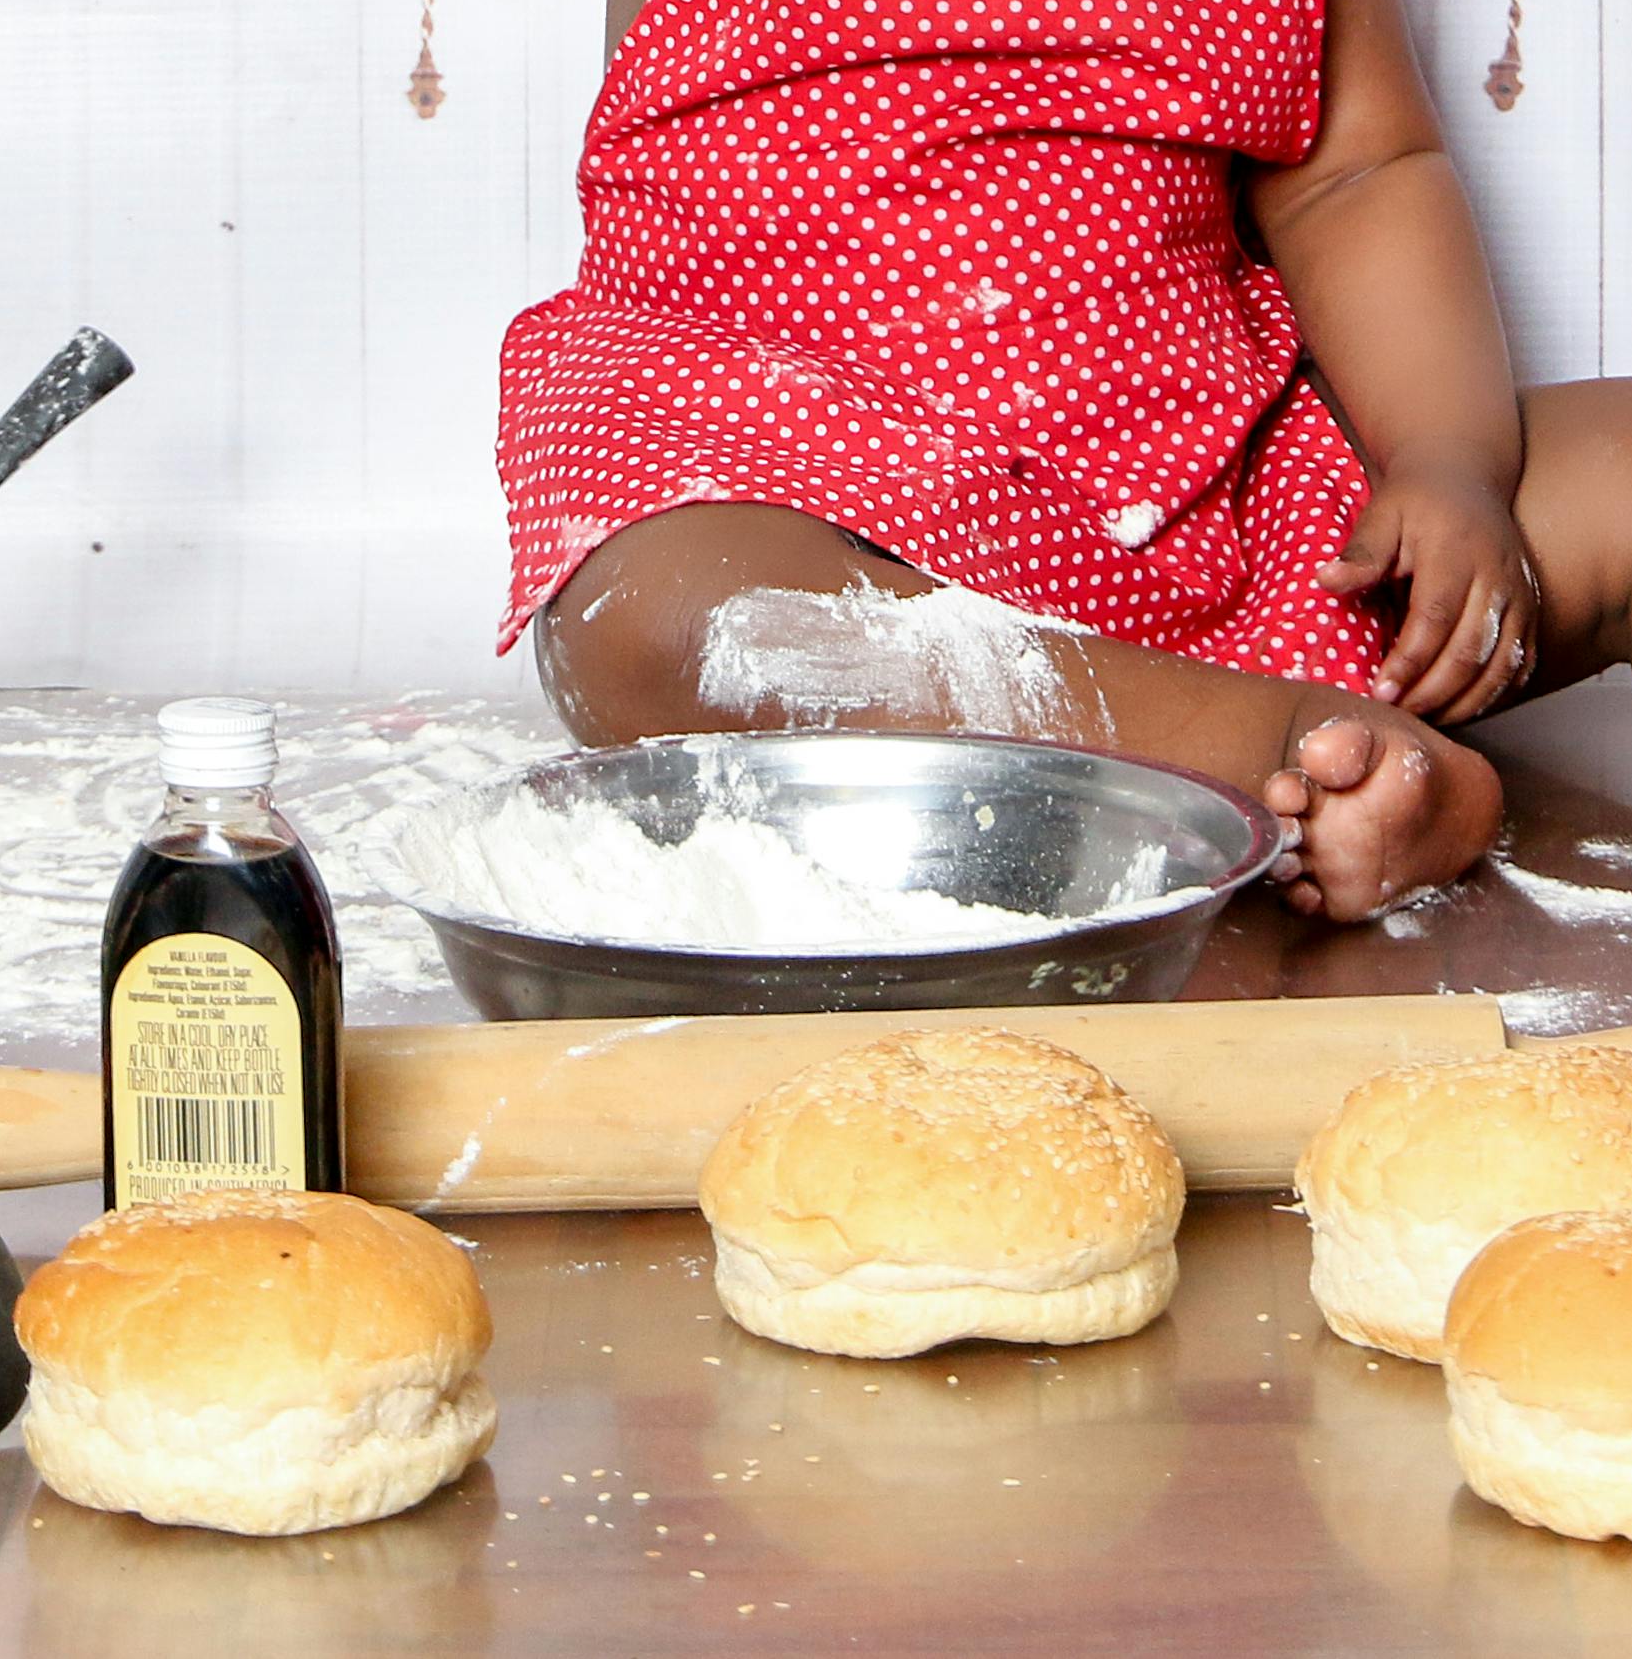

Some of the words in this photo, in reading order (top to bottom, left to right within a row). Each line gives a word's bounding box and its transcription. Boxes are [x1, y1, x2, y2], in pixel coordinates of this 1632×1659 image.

[137, 1021, 165, 1045] STORE
[168, 1022, 177, 1045] IN
[180, 1023, 186, 1046] A
[218, 1024, 237, 1047] DRY
[240, 1024, 269, 1047] PLACE
[140, 1044, 157, 1069] ALL
[158, 1045, 189, 1071] TIMES
[191, 1047, 212, 1071] AND
[215, 1048, 241, 1072] KEEP
[244, 1048, 281, 1072] BOTTLE
[161, 1070, 197, 1094] CLOSED
[199, 1072, 228, 1094] WHEN
[230, 1072, 249, 1095] NOT
[253, 1072, 264, 1095] IN
[266, 1072, 286, 1095] USE
